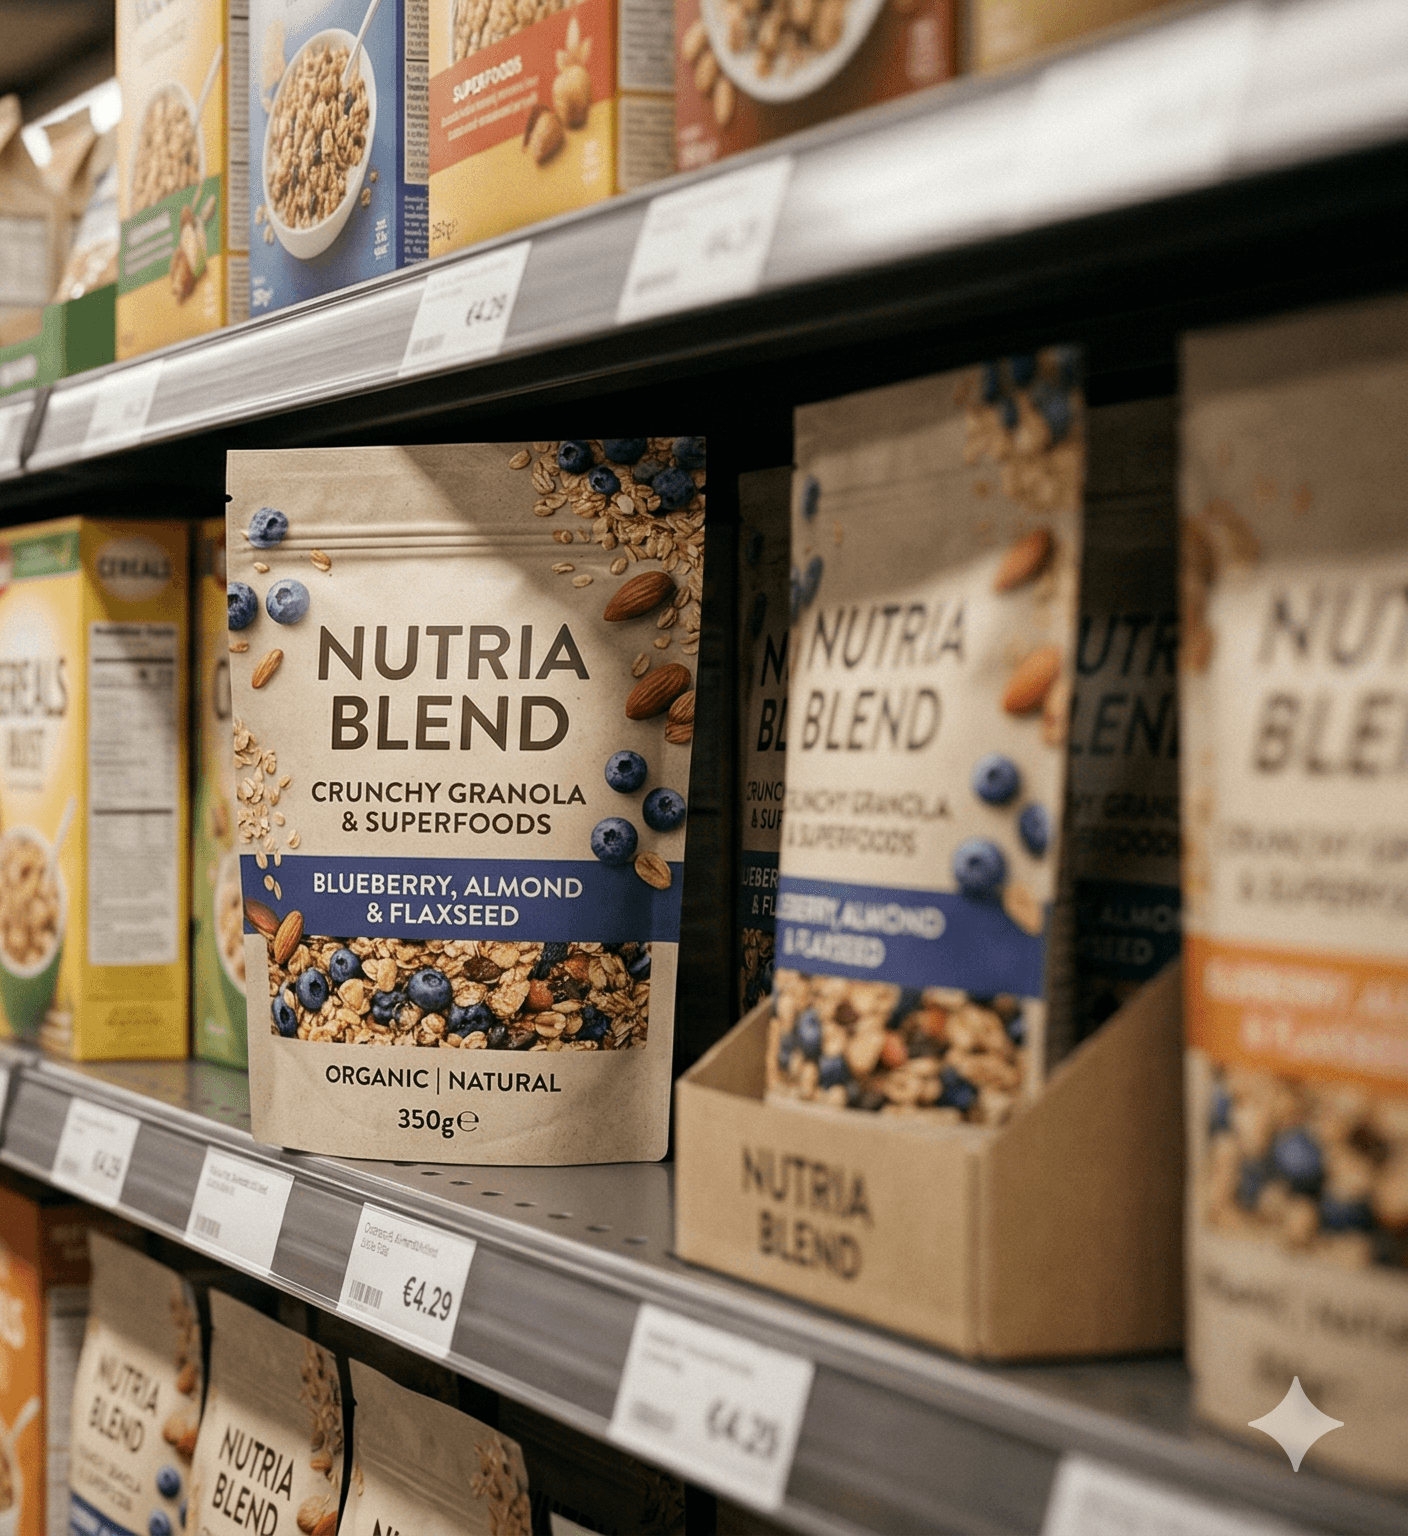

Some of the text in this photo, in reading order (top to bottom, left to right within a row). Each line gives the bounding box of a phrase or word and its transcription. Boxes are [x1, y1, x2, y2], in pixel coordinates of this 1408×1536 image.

[318, 624, 590, 681] NUTRIA
[805, 603, 964, 671] NUTRIA
[331, 695, 570, 752] BLEND
[802, 687, 942, 751] BLEND
[311, 782, 586, 805] CRUNCHY GRANOLA
[341, 811, 551, 835] & SUPERFOODS
[313, 873, 583, 899] BLUEBERRY, ALMOND
[366, 903, 520, 927] & FLAXSEED
[325, 1064, 562, 1093] ORGANIC NATURAL
[742, 1147, 874, 1230] NUTRIA
[759, 1209, 863, 1281] BLEND
[403, 1276, 453, 1321] €4.29
[99, 1355, 160, 1416] NUTRIA
[90, 1395, 144, 1453] BLEND
[218, 1423, 294, 1502] NUTRIA
[212, 1472, 279, 1536] BLEND
